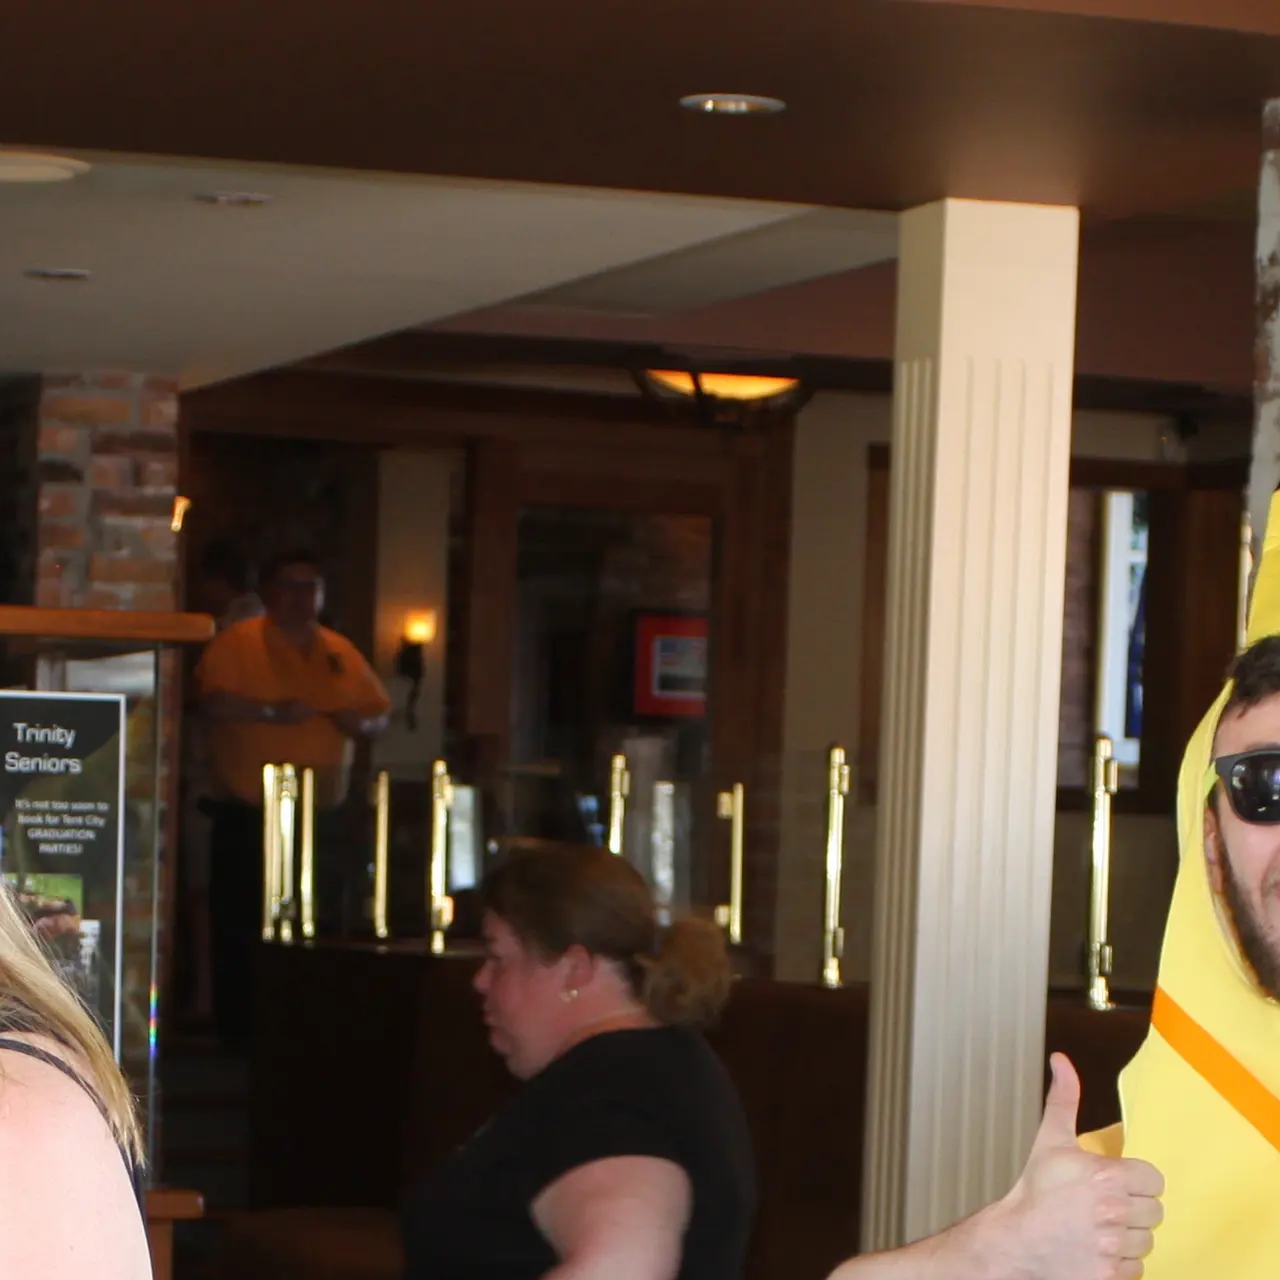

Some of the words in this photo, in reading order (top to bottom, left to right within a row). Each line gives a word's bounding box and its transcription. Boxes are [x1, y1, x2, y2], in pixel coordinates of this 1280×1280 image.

[12, 722, 77, 749] Trinity
[4, 751, 83, 775] Seniors
[51, 800, 69, 810] too
[27, 827, 97, 840] GRADUATION
